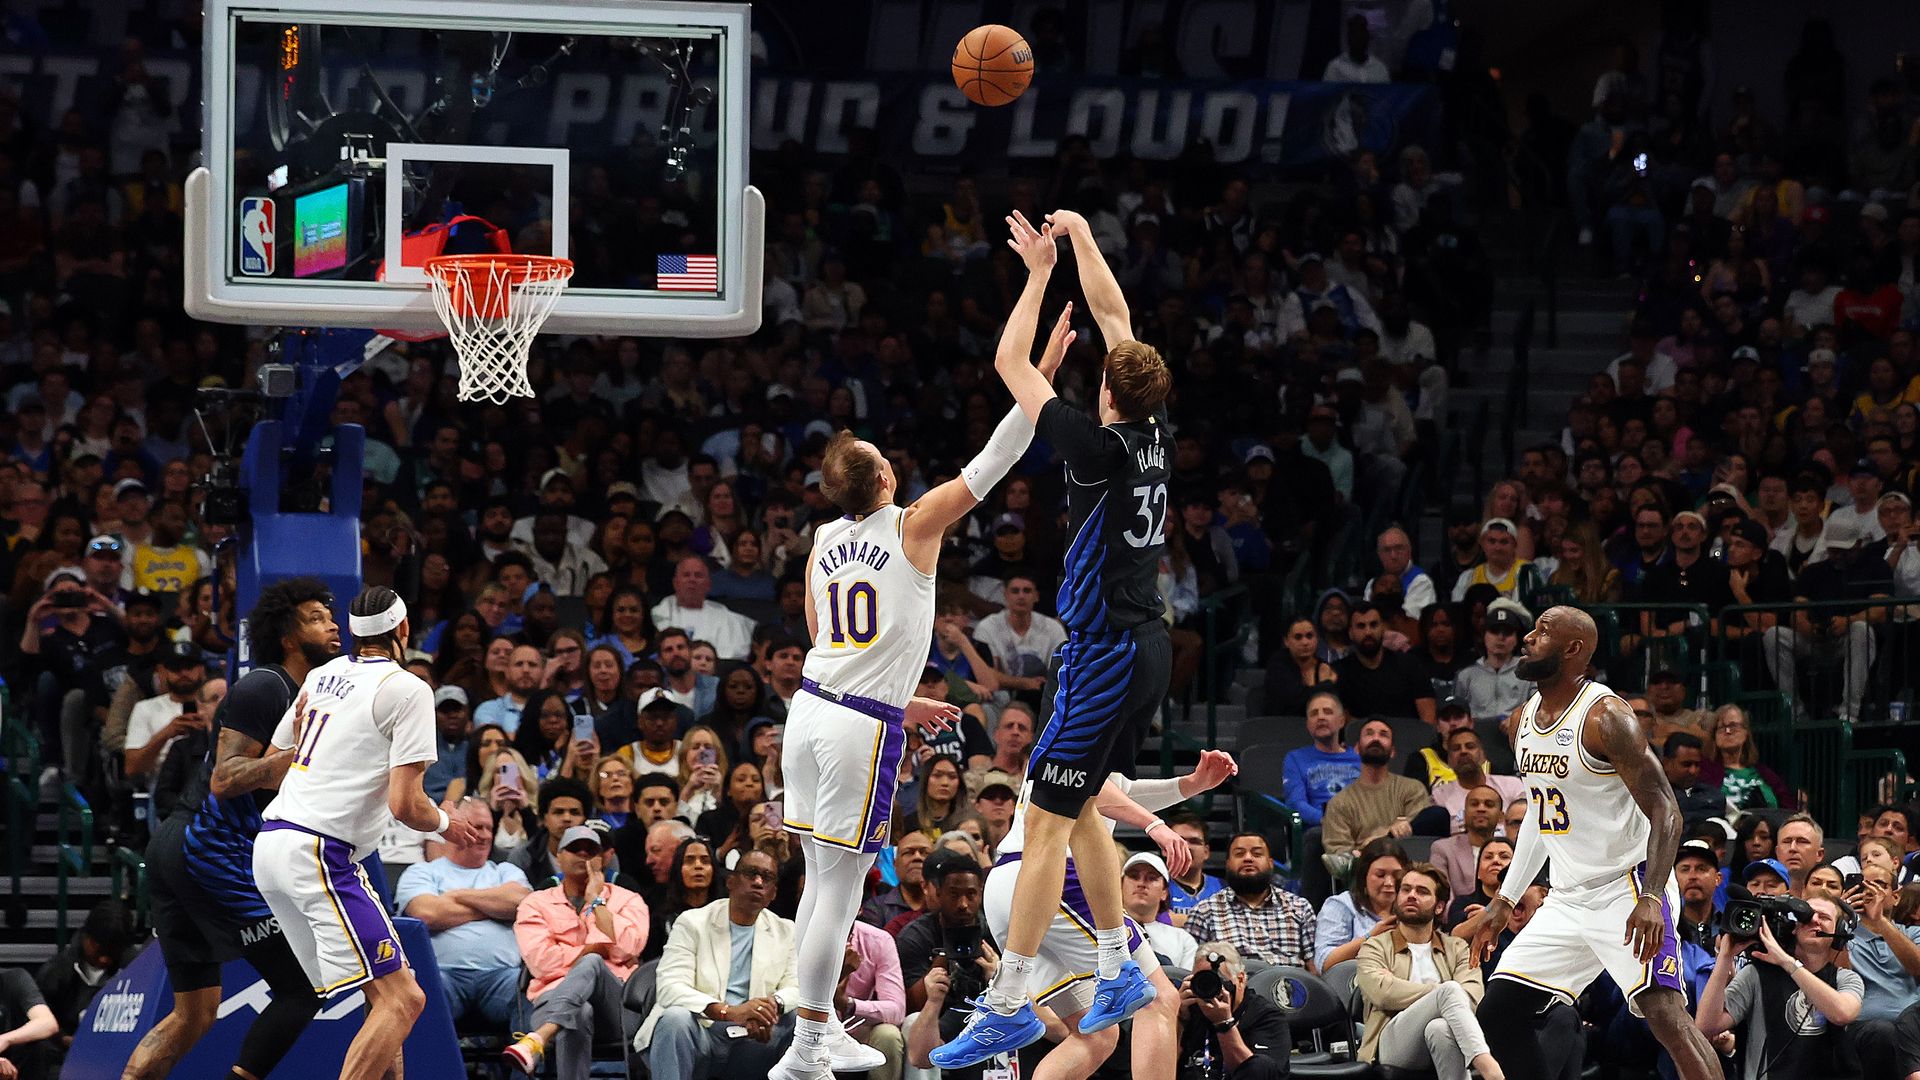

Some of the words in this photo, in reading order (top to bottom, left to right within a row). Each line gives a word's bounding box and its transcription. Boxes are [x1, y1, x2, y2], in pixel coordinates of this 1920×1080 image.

[911, 84, 977, 157] &
[1006, 84, 1292, 164] LOUD!
[1136, 444, 1166, 473] FLAGG
[1123, 483, 1168, 548] 32
[819, 541, 891, 577] KENNARD
[826, 580, 880, 649] 10
[315, 675, 356, 700] HAYES
[290, 708, 332, 772] 11
[1041, 762, 1087, 788] MAVS
[1520, 747, 1570, 779] LAKERS
[1529, 784, 1571, 835] 23
[240, 917, 281, 946] MAVS
